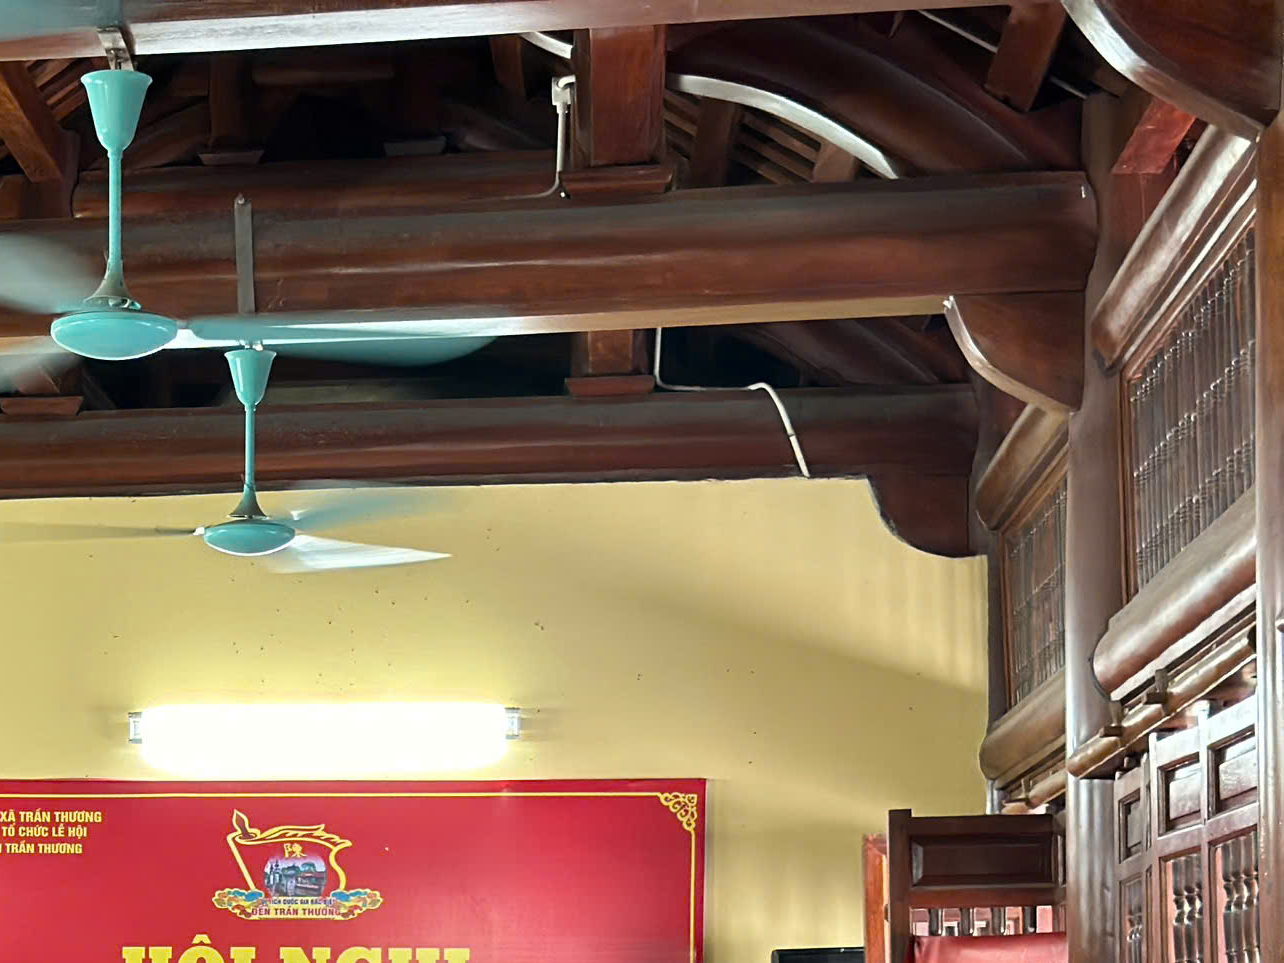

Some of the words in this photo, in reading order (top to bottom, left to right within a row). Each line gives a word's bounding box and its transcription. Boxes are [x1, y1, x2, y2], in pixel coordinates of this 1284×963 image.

[0, 809, 16, 823] XÃ
[19, 808, 51, 823] TRẦN
[54, 811, 102, 823] THƯƠNG
[1, 823, 16, 837] TỔ
[18, 824, 49, 837] CHỨC
[51, 823, 65, 837] LỄ
[68, 824, 87, 839] HỘI
[5, 840, 35, 854] TRẦN
[37, 842, 83, 854] THƯƠNG
